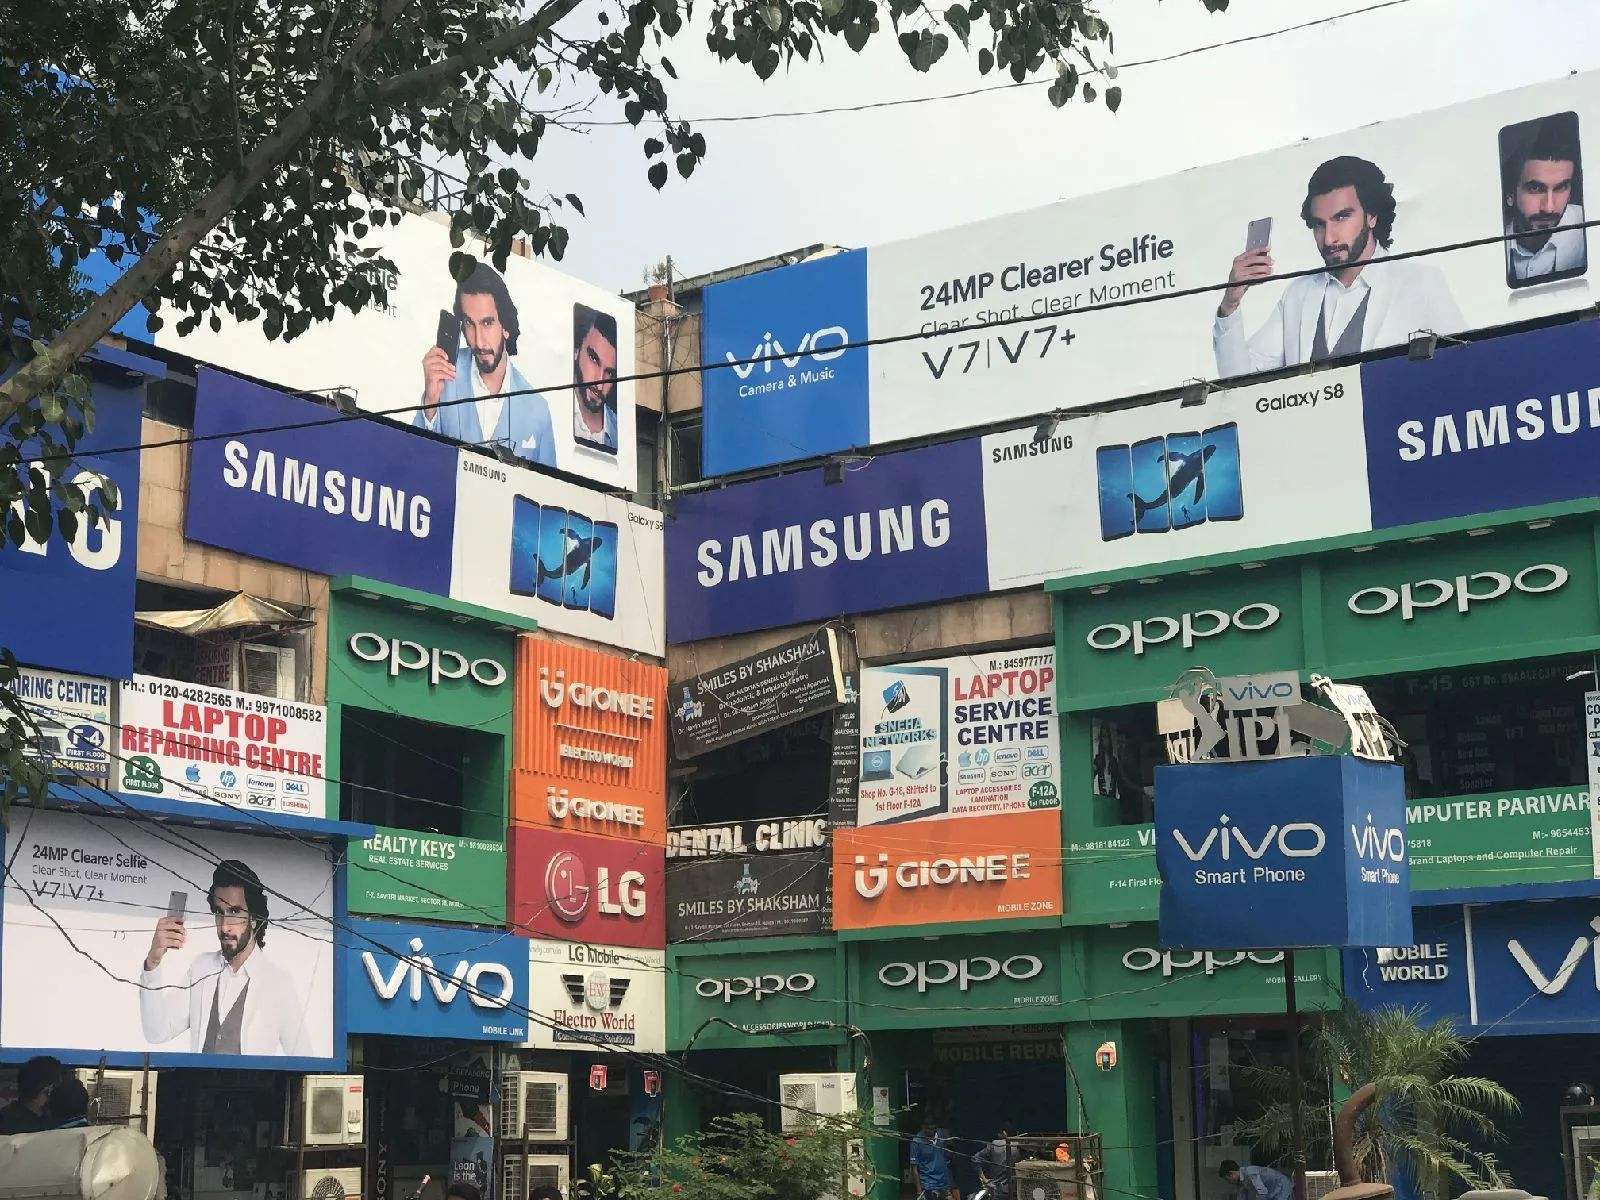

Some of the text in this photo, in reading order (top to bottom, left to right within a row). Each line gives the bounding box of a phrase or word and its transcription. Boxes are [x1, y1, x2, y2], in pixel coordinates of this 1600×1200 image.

[920, 233, 1175, 312] 24MP Clearer Selfie
[920, 315, 969, 341] Clear
[1030, 292, 1079, 319] Clear
[1088, 270, 1177, 306] Moment
[725, 325, 850, 380] vivo
[738, 365, 836, 399] Camera & Music
[1254, 382, 1345, 415] Galaxy S8
[991, 435, 1074, 465] SAMSUNG
[462, 459, 507, 484] SAMSUNG
[222, 440, 432, 539] SAMSUNG
[627, 511, 655, 531] Galaxy
[696, 497, 951, 589] SAMSUNG
[1346, 562, 1570, 622] oppo
[1085, 601, 1281, 656] oppo
[348, 631, 508, 687] oppo
[697, 670, 737, 695] SMILES
[739, 662, 753, 680] BY
[755, 640, 820, 674] SHAKSHAM
[989, 659, 1002, 671] M.:
[57, 679, 108, 707] CENTER
[954, 667, 1055, 702] LAPTOP
[1228, 681, 1293, 701] vivo
[149, 682, 232, 709] 0120-4282565
[235, 697, 252, 712] M.:
[255, 699, 323, 723] 9971008582
[568, 681, 656, 721] GIONEE
[954, 697, 1053, 724] SERVICE
[162, 699, 288, 745] LAPTOP
[875, 716, 923, 735] SNEHA
[957, 720, 1049, 746] CENTRE
[121, 723, 322, 778] REPAIRING CENTRE
[862, 728, 937, 748] NETWORKS
[67, 749, 106, 759] FIRST FLOOR
[125, 777, 140, 788] FIRST
[990, 769, 1016, 778] SONY
[1024, 764, 1051, 777] acer
[213, 790, 241, 801] SONY
[860, 789, 876, 800] Shop
[877, 787, 888, 798] No.
[930, 783, 937, 793] to
[955, 784, 1022, 796] LAPTOP ACCESSORIES
[970, 793, 1009, 803] LAMINATION
[1031, 785, 1055, 798] F-12A
[1038, 797, 1058, 806] FLOOR
[569, 796, 646, 826] GIONEE
[875, 798, 922, 812] 1st Floor F-12A
[952, 806, 968, 814] DATA
[968, 803, 1003, 812] RECOVERY,
[1405, 791, 1592, 825] MPUTER PARIVAR
[420, 839, 456, 860] KEYS
[665, 818, 826, 859] DENTAL CLINIC
[1172, 814, 1326, 862] vivo
[1351, 812, 1405, 862] vivo
[32, 843, 148, 870] 24MP Clearer Selfie
[368, 854, 449, 871] REAL ESTATE SERVICES
[1436, 853, 1473, 865] Laptops
[1477, 850, 1494, 861] and
[1496, 848, 1545, 861] Computer
[1546, 846, 1578, 857] Repair
[32, 864, 148, 884] Clear Shot, Clear Moment
[895, 852, 1031, 889] GIONEE
[1194, 866, 1306, 884] Smart Phone
[1360, 866, 1400, 884] Smart Phone
[596, 866, 647, 919] LG
[1109, 879, 1147, 889] F-14 First
[678, 893, 820, 918] SMILES BY SHAKSHAM
[568, 944, 585, 963] LG
[587, 946, 620, 964] Mobile
[361, 936, 515, 1010] vivo
[877, 953, 1043, 994] oppo
[1380, 963, 1449, 983] WORLD
[694, 972, 816, 1003] oppo
[482, 1024, 509, 1036] MOBILE
[553, 1009, 636, 1031] Electro World
[453, 1160, 476, 1172] Lean
[461, 1171, 477, 1182] the
